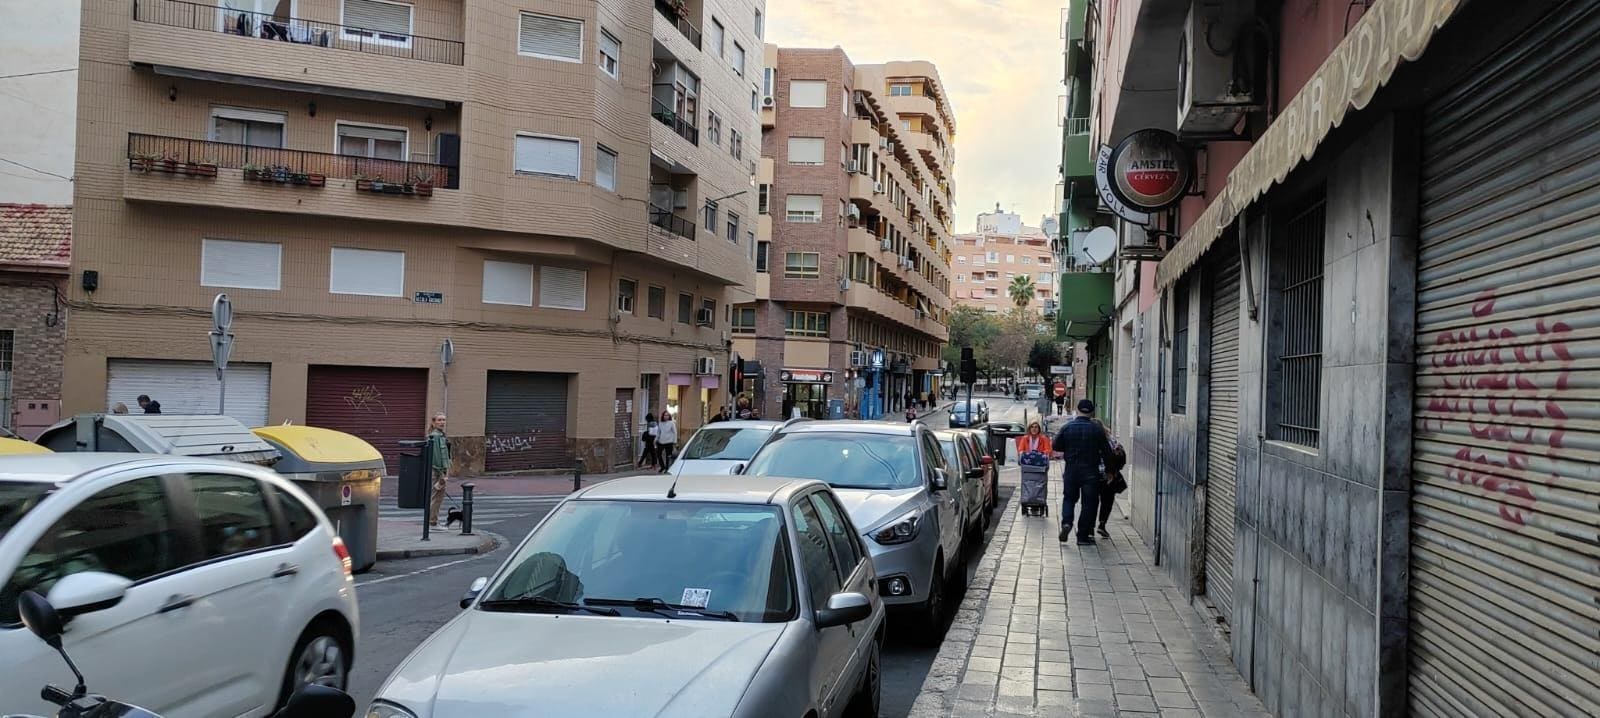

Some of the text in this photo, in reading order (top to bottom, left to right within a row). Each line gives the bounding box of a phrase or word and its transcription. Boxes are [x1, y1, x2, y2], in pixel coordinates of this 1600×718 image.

[1131, 159, 1175, 170] AMSTEL
[1134, 172, 1170, 180] CERVEZA
[1098, 150, 1126, 217] BAR YOLA
